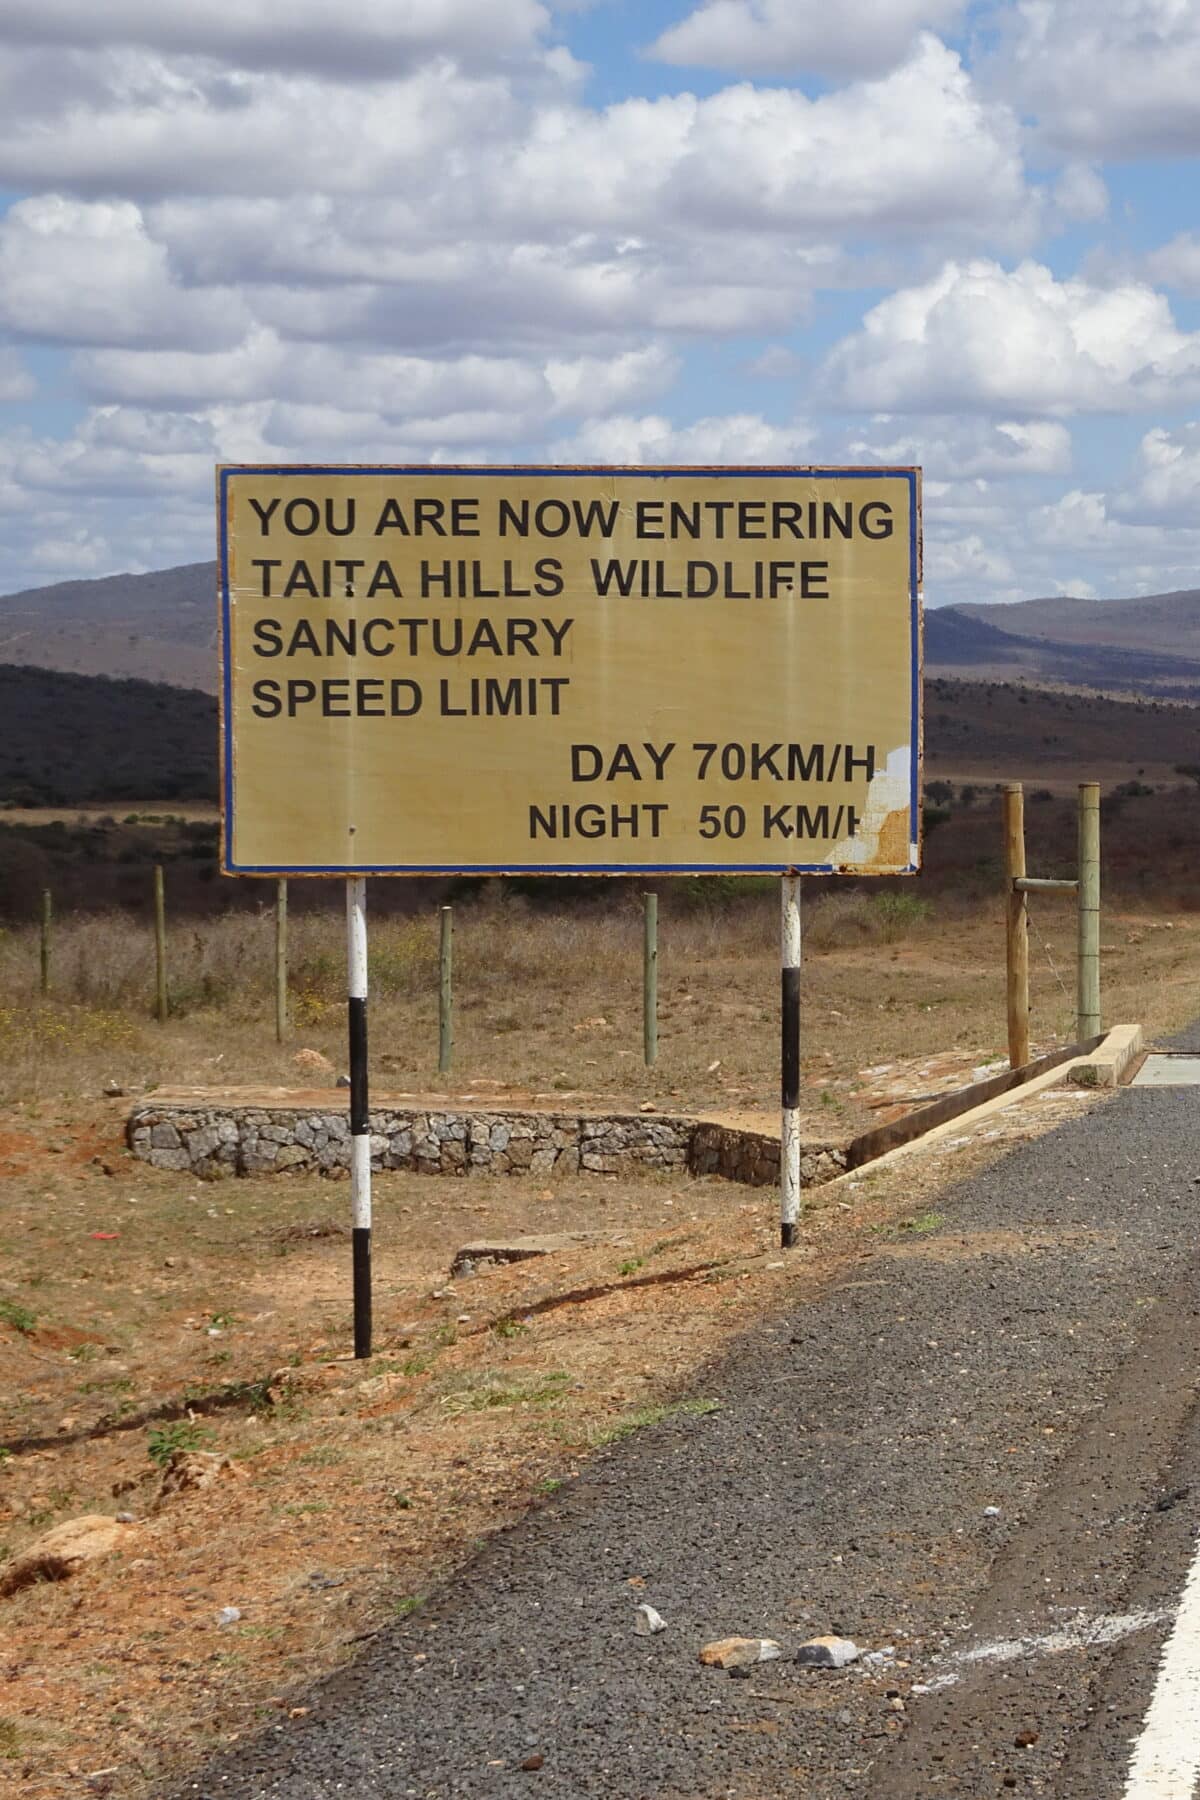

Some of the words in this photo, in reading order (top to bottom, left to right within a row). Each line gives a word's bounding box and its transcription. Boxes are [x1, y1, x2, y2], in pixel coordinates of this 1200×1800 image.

[248, 497, 357, 537] YOU
[374, 498, 481, 537] ARE
[499, 499, 619, 538] NOW
[636, 501, 894, 539] ENTERING
[252, 559, 402, 598] TAITA
[421, 558, 565, 598] HILLS
[591, 558, 829, 599] WILDLIFE
[252, 618, 574, 658] SANCTUARY
[252, 678, 423, 718] SPEED
[440, 678, 570, 717] LIMIT
[571, 743, 676, 782] DAY
[693, 742, 876, 783] 70KM/H
[530, 804, 669, 839] NIGHT
[698, 804, 747, 839] 50
